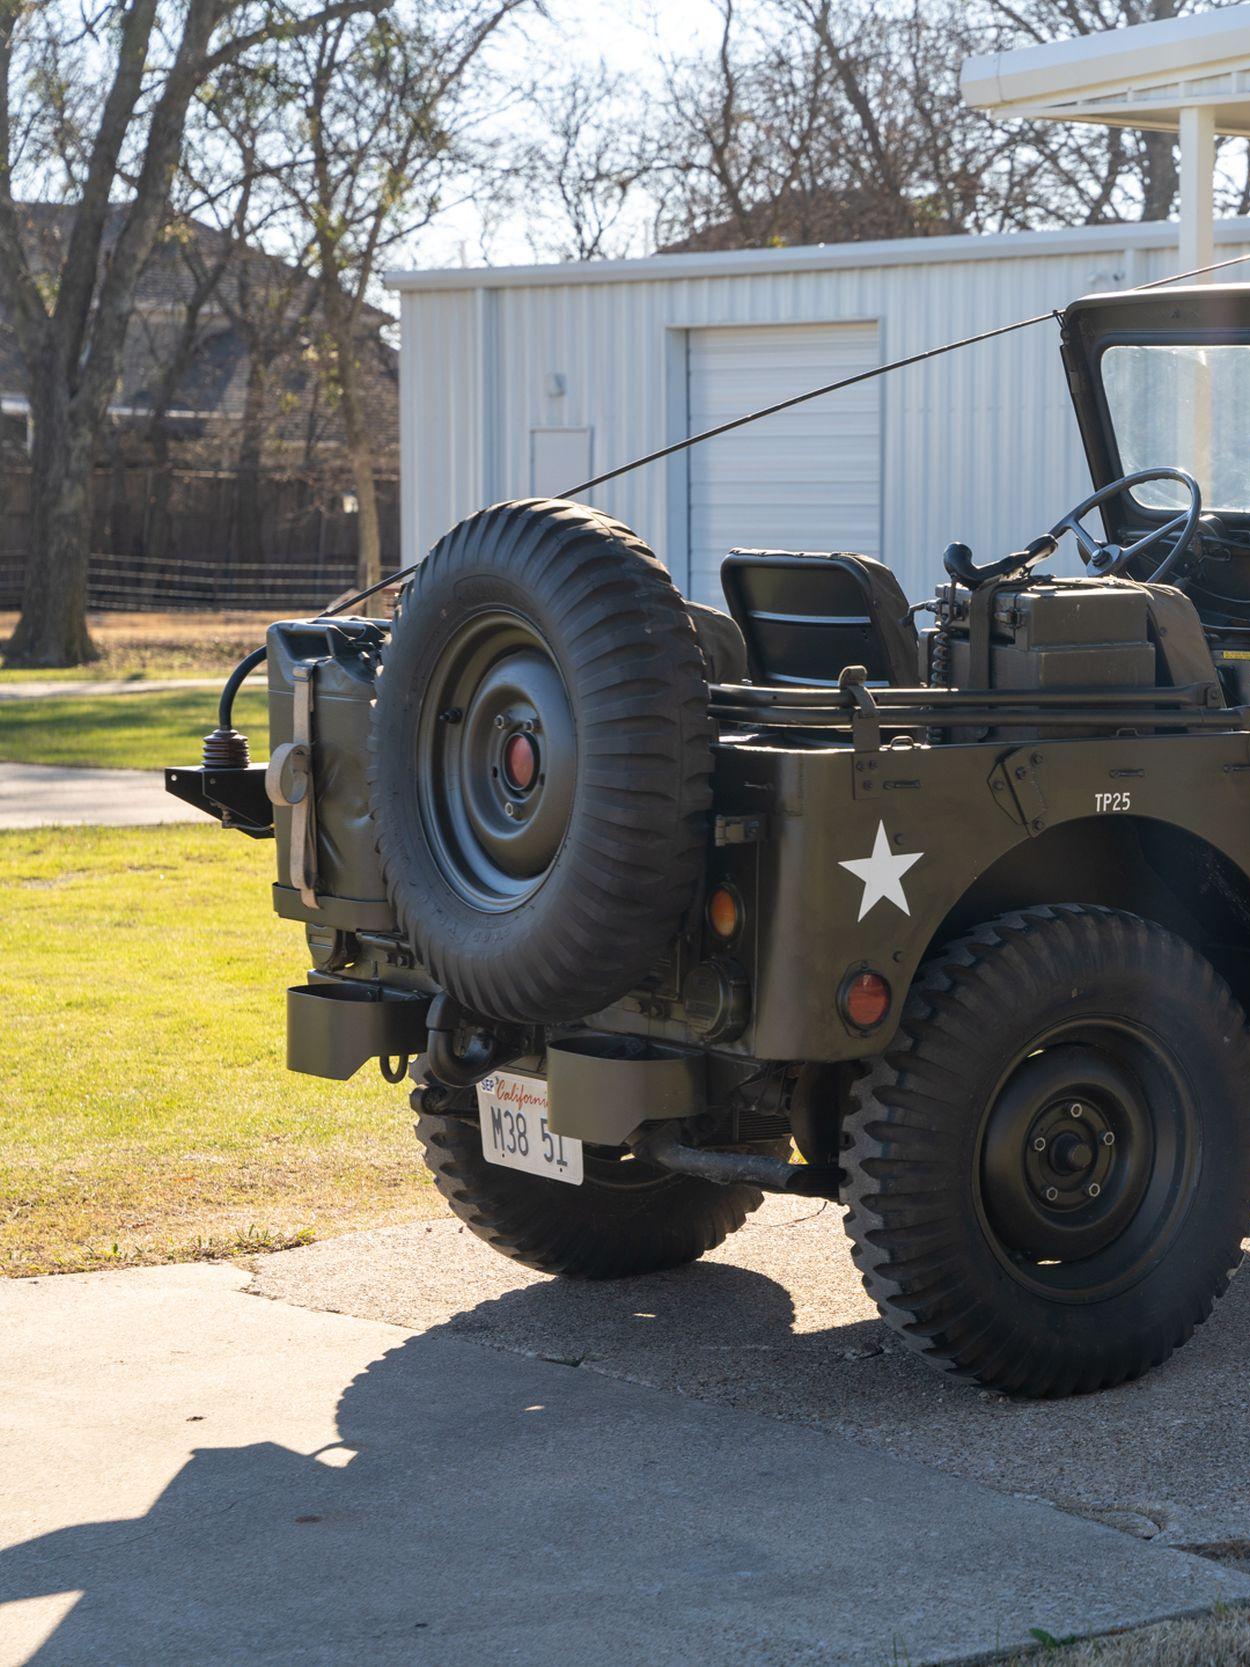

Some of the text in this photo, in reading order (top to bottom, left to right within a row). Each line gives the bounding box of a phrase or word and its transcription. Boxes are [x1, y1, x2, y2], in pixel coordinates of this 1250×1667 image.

[1095, 792, 1131, 813] TP25
[496, 1079, 549, 1110] Californi
[490, 1106, 529, 1157] M38
